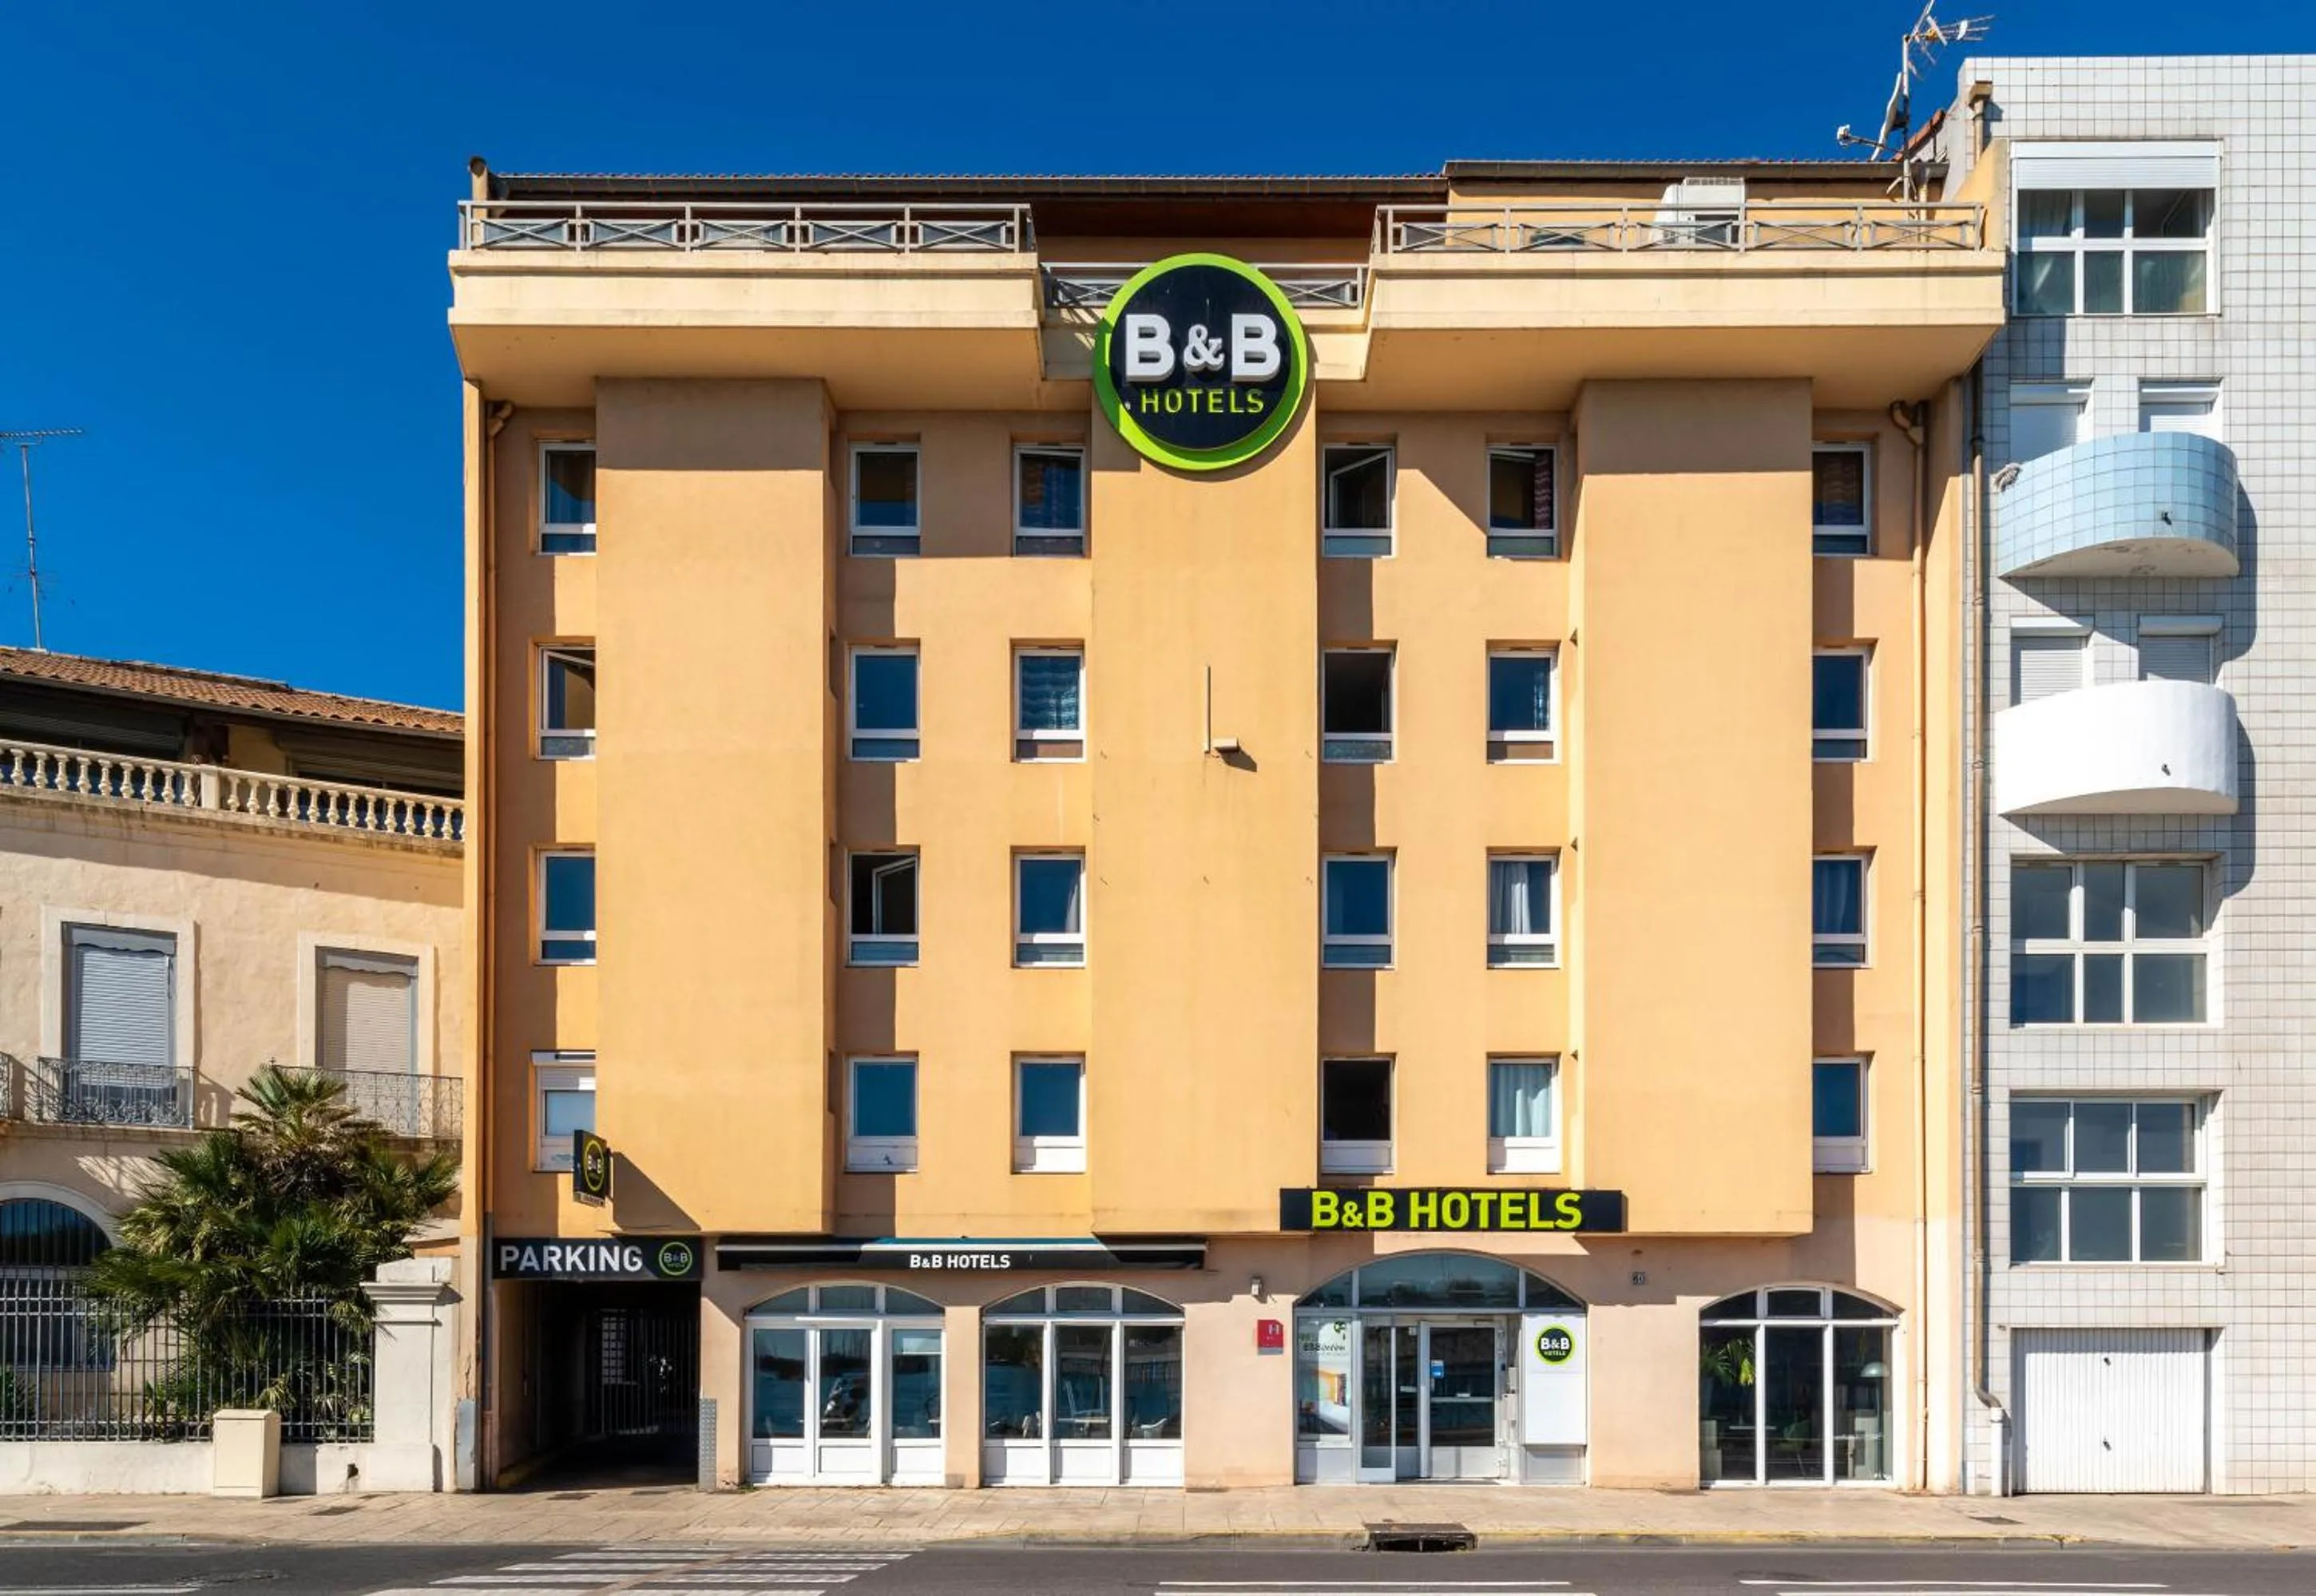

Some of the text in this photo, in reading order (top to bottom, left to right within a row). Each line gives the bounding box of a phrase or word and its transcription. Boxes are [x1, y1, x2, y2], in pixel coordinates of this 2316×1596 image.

[1125, 313, 1281, 382] B&B
[1140, 388, 1264, 414] HOTELS
[1311, 1190, 1582, 1229] B&B HOTELS
[500, 1245, 643, 1272] PARKING
[910, 1253, 1011, 1269] B&B HOTELS
[1541, 1337, 1570, 1350] B&B
